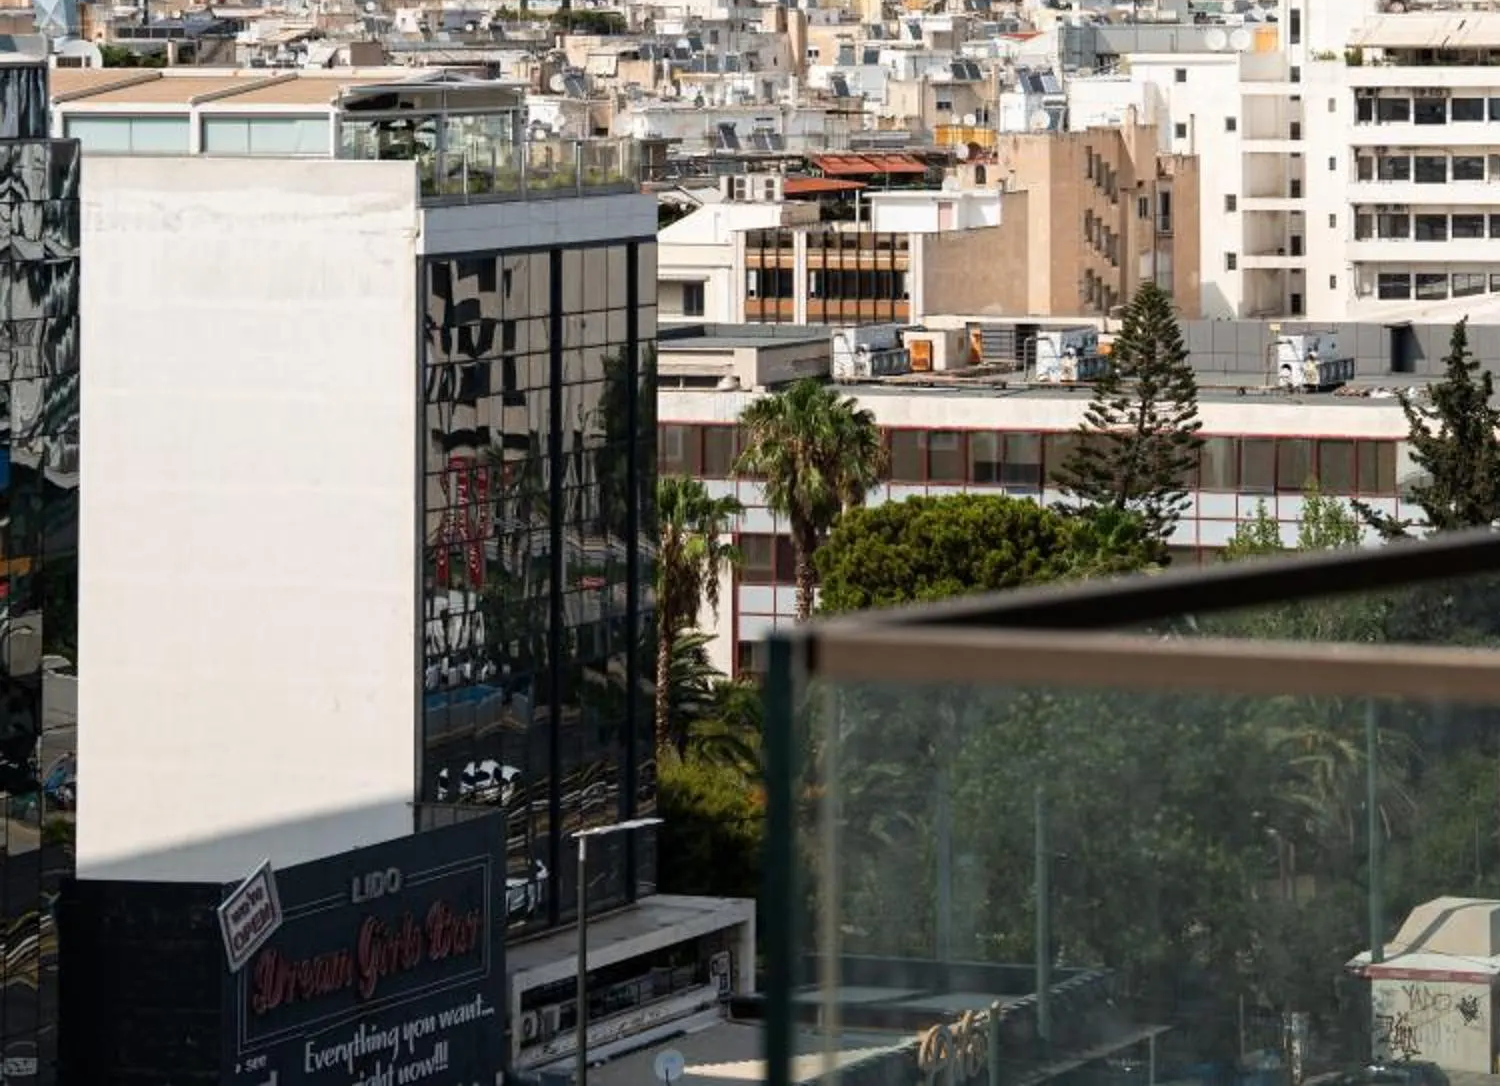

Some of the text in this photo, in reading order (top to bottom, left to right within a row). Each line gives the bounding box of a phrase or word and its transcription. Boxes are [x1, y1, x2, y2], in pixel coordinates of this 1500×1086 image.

[352, 867, 400, 903] LIDO
[253, 899, 482, 1014] Dream Girls Bar
[304, 1023, 400, 1074] Everything
[403, 1015, 436, 1054] you
[398, 1040, 449, 1085] now!!!
